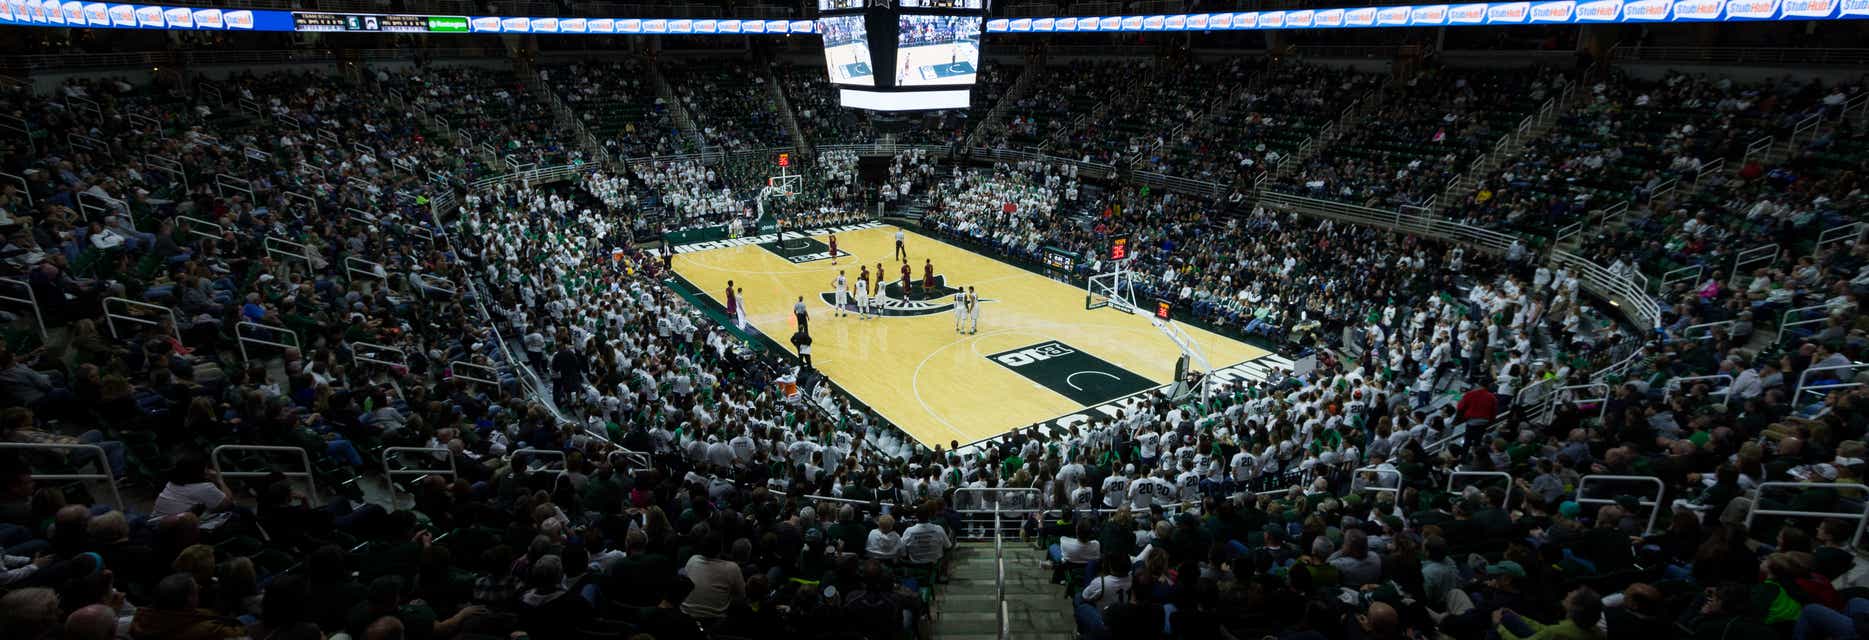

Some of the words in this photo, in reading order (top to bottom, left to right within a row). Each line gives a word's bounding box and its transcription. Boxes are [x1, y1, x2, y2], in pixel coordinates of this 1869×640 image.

[1534, 5, 1571, 16] StubHub!
[1579, 4, 1619, 16] StubHub!
[1626, 3, 1668, 15] StubHub!
[1677, 1, 1720, 14] StubHub!
[1730, 0, 1775, 13] StubHub!
[1785, 0, 1833, 11] StubHub!
[1112, 245, 1124, 259] 35
[1241, 457, 1252, 466] 20
[1111, 481, 1124, 491] 20
[1186, 475, 1198, 487] 20
[1139, 483, 1153, 494] 20
